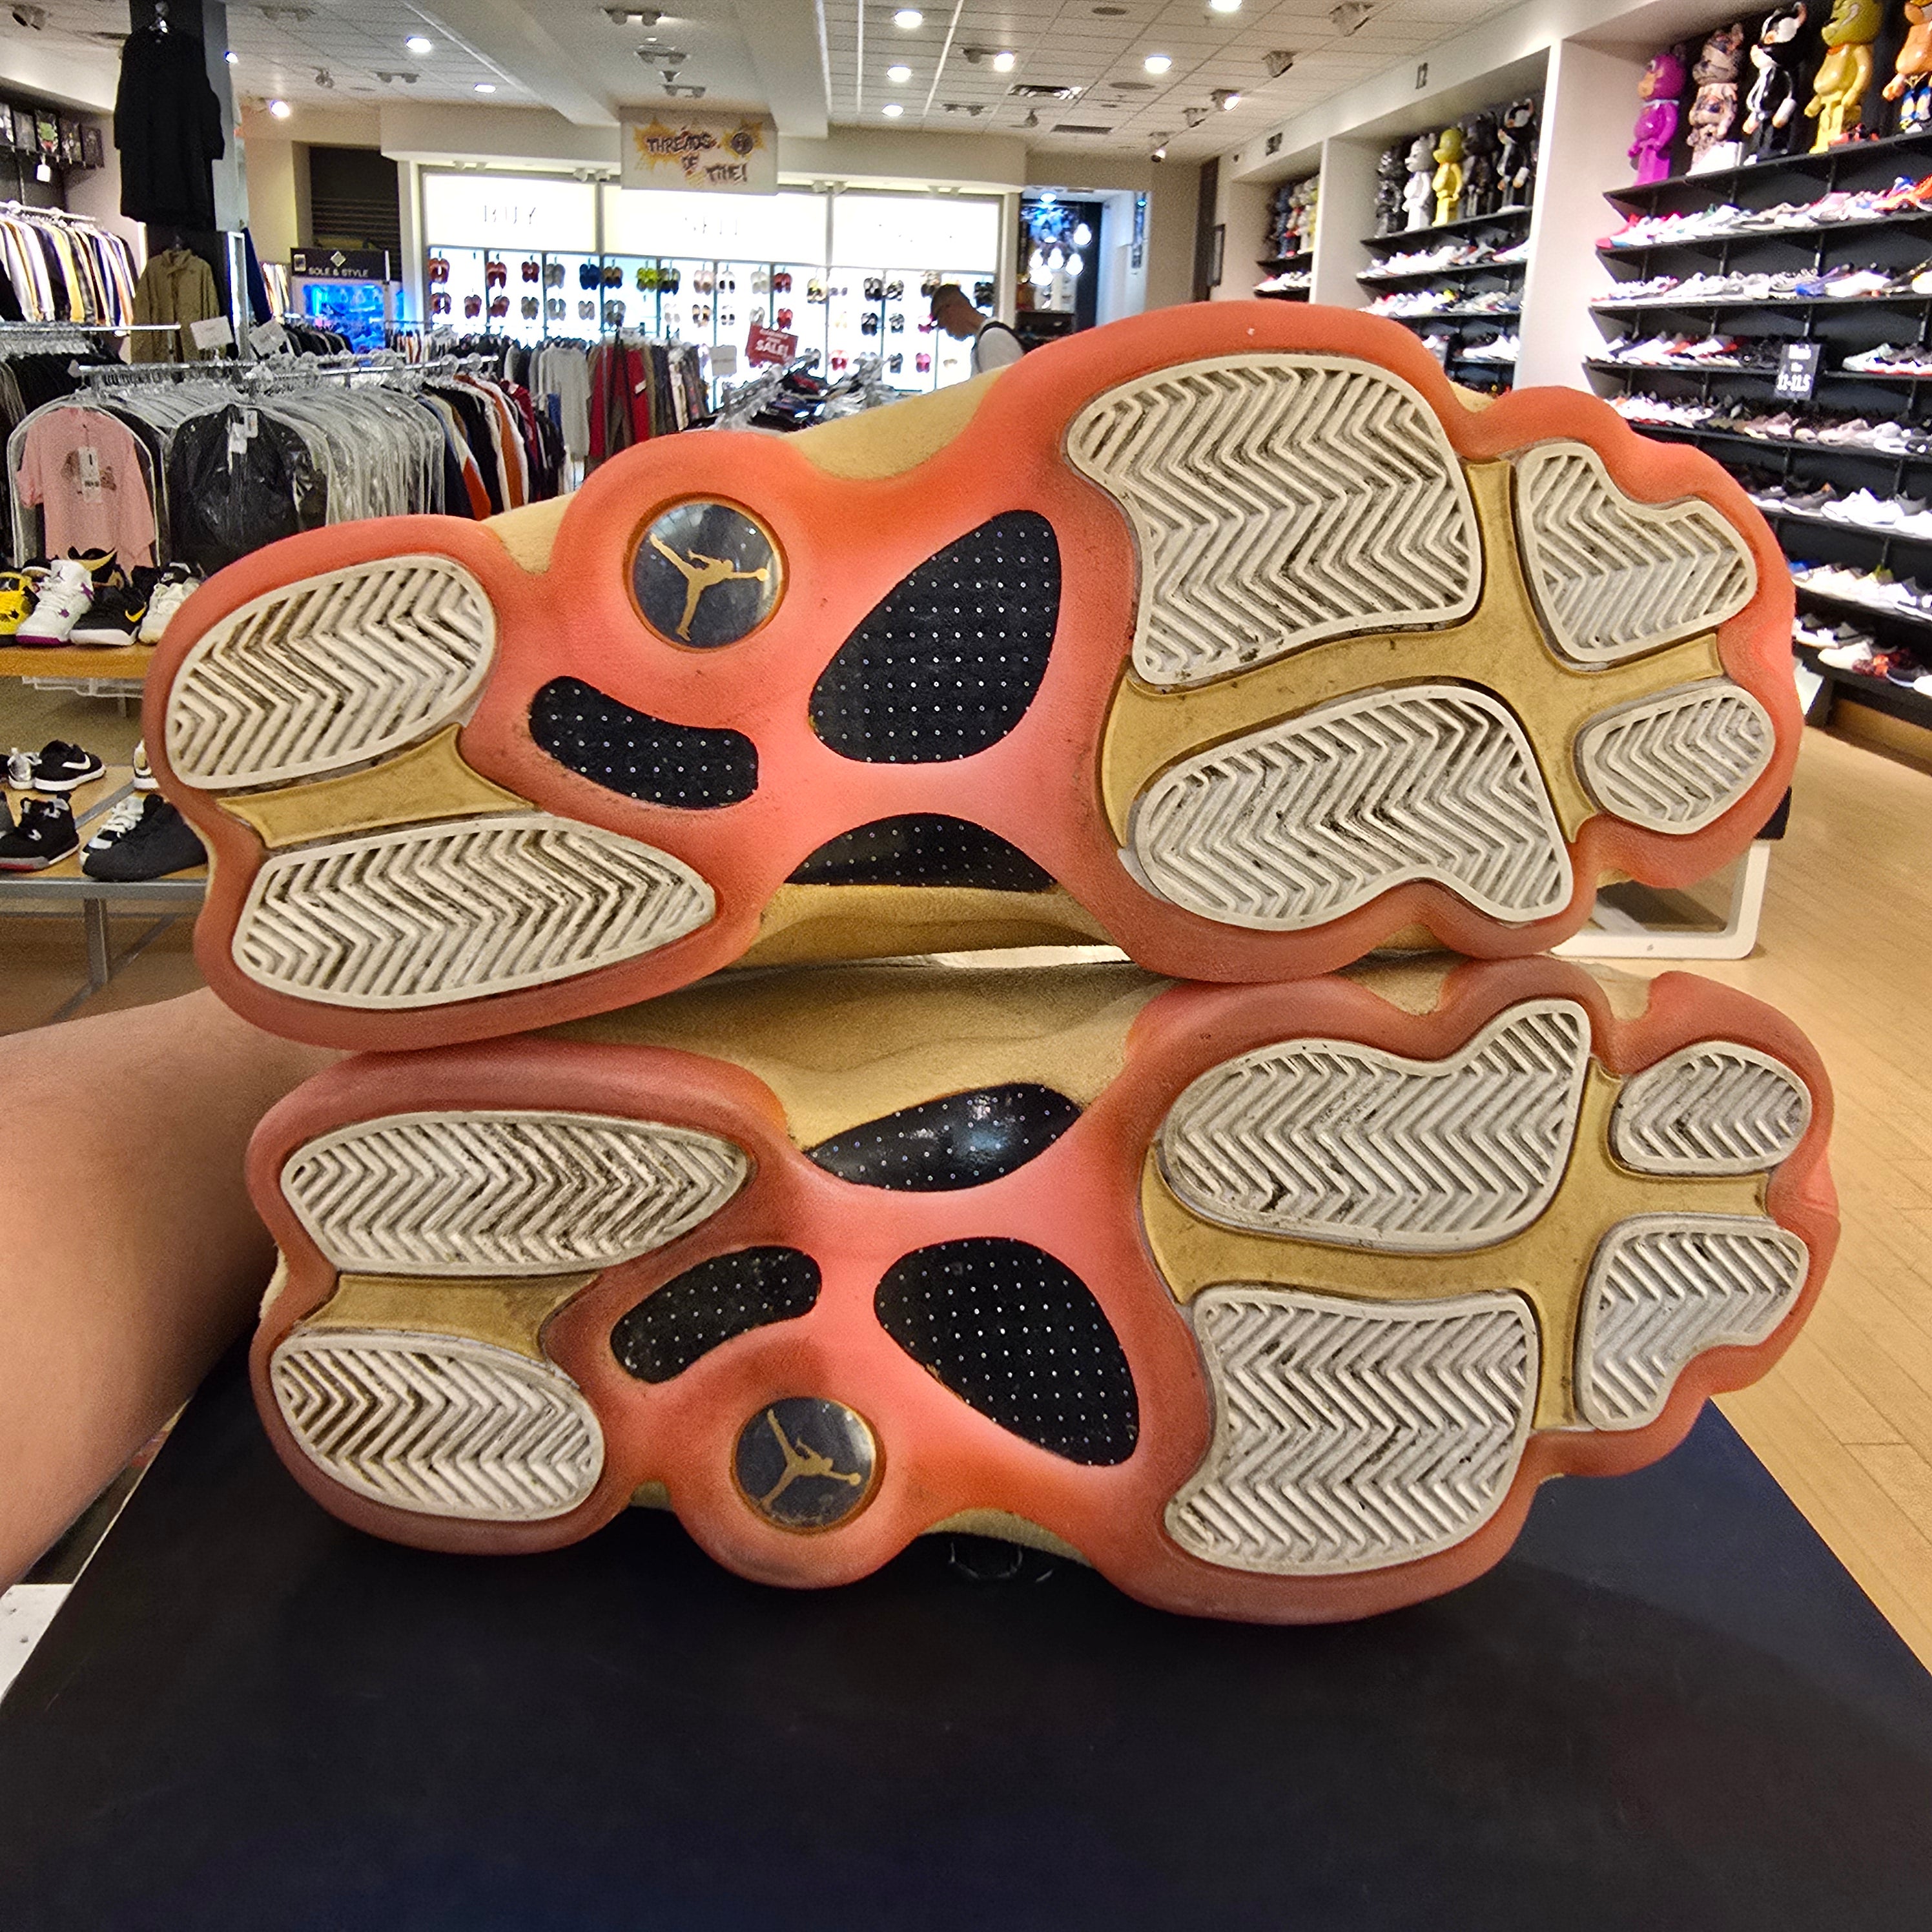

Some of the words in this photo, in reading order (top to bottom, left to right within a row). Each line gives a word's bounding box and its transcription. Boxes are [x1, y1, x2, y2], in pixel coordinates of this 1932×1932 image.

[308, 267, 330, 276] SOLE
[333, 268, 340, 277] &
[341, 268, 369, 278] STYLE
